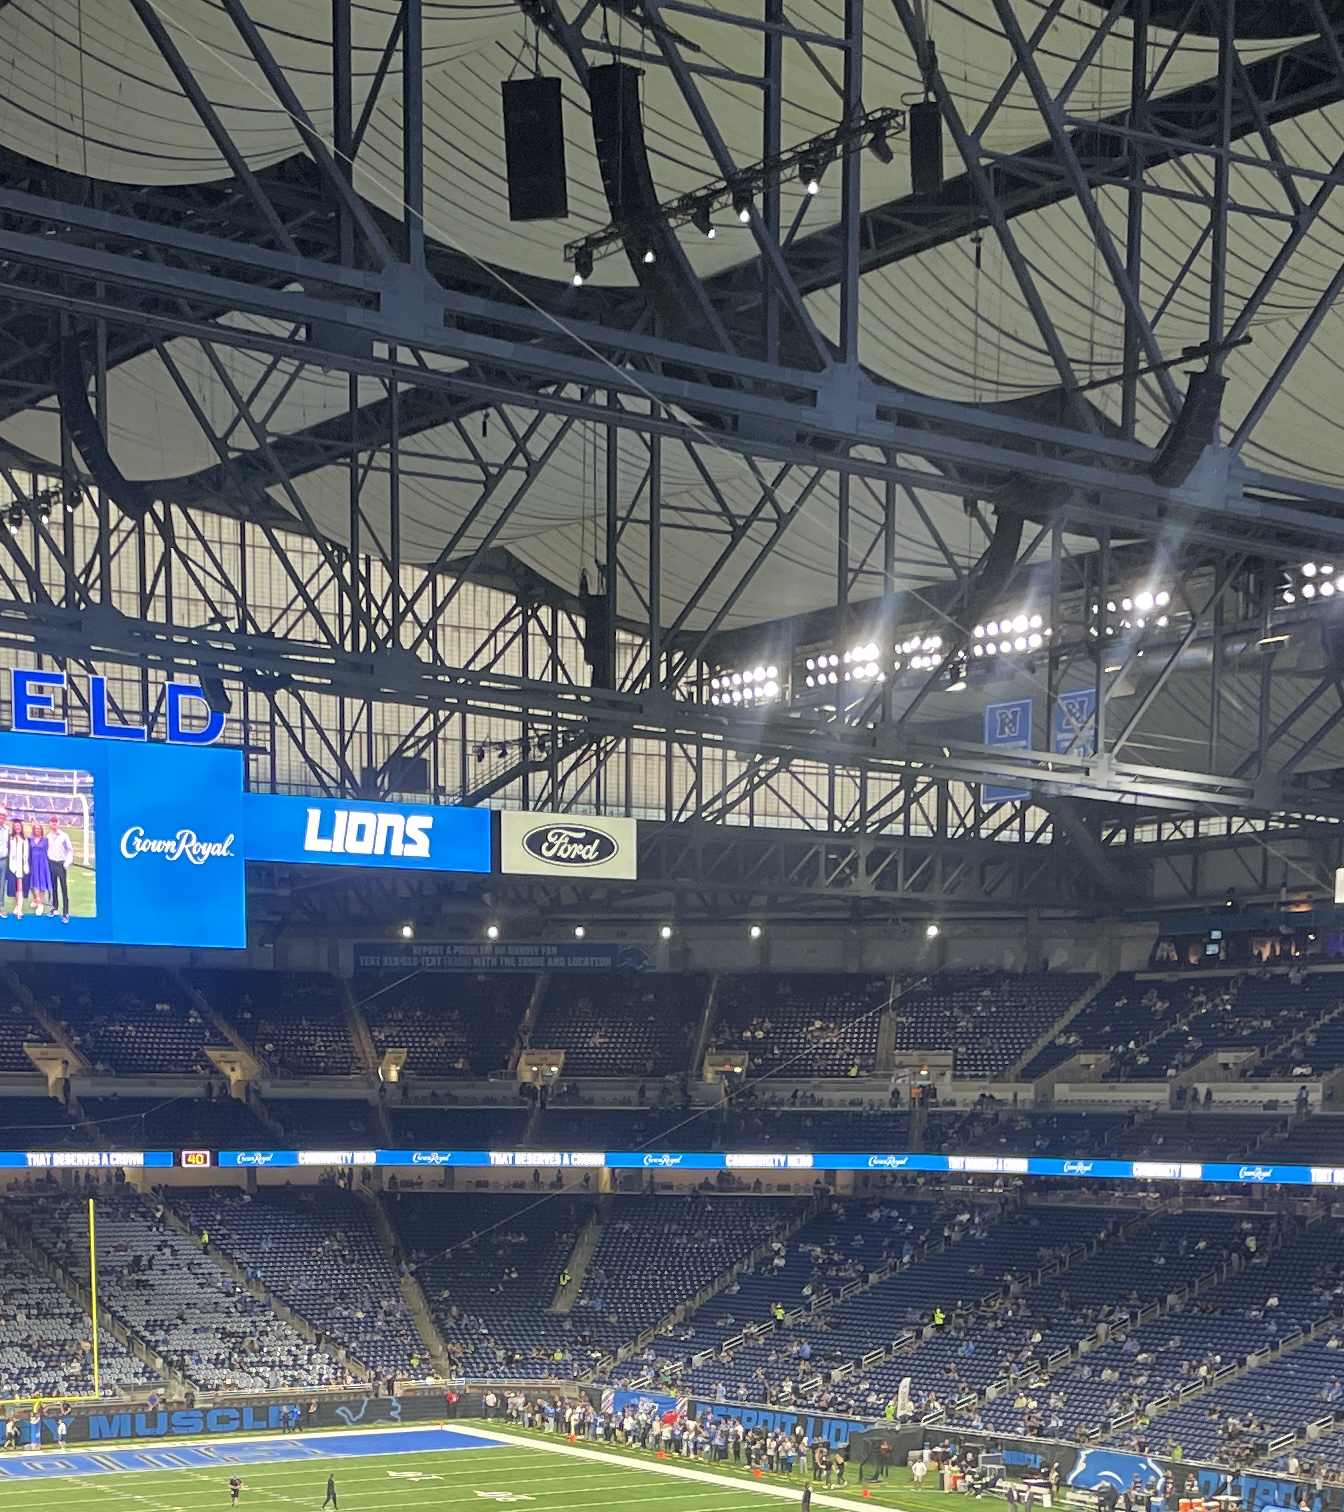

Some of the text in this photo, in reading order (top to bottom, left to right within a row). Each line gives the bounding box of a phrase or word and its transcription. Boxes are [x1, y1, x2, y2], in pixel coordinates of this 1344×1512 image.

[120, 826, 177, 859] Crown
[304, 808, 433, 858] LIONS
[540, 829, 599, 861] Ford
[186, 1153, 205, 1165] 40
[89, 1404, 297, 1439] MUSCLE
